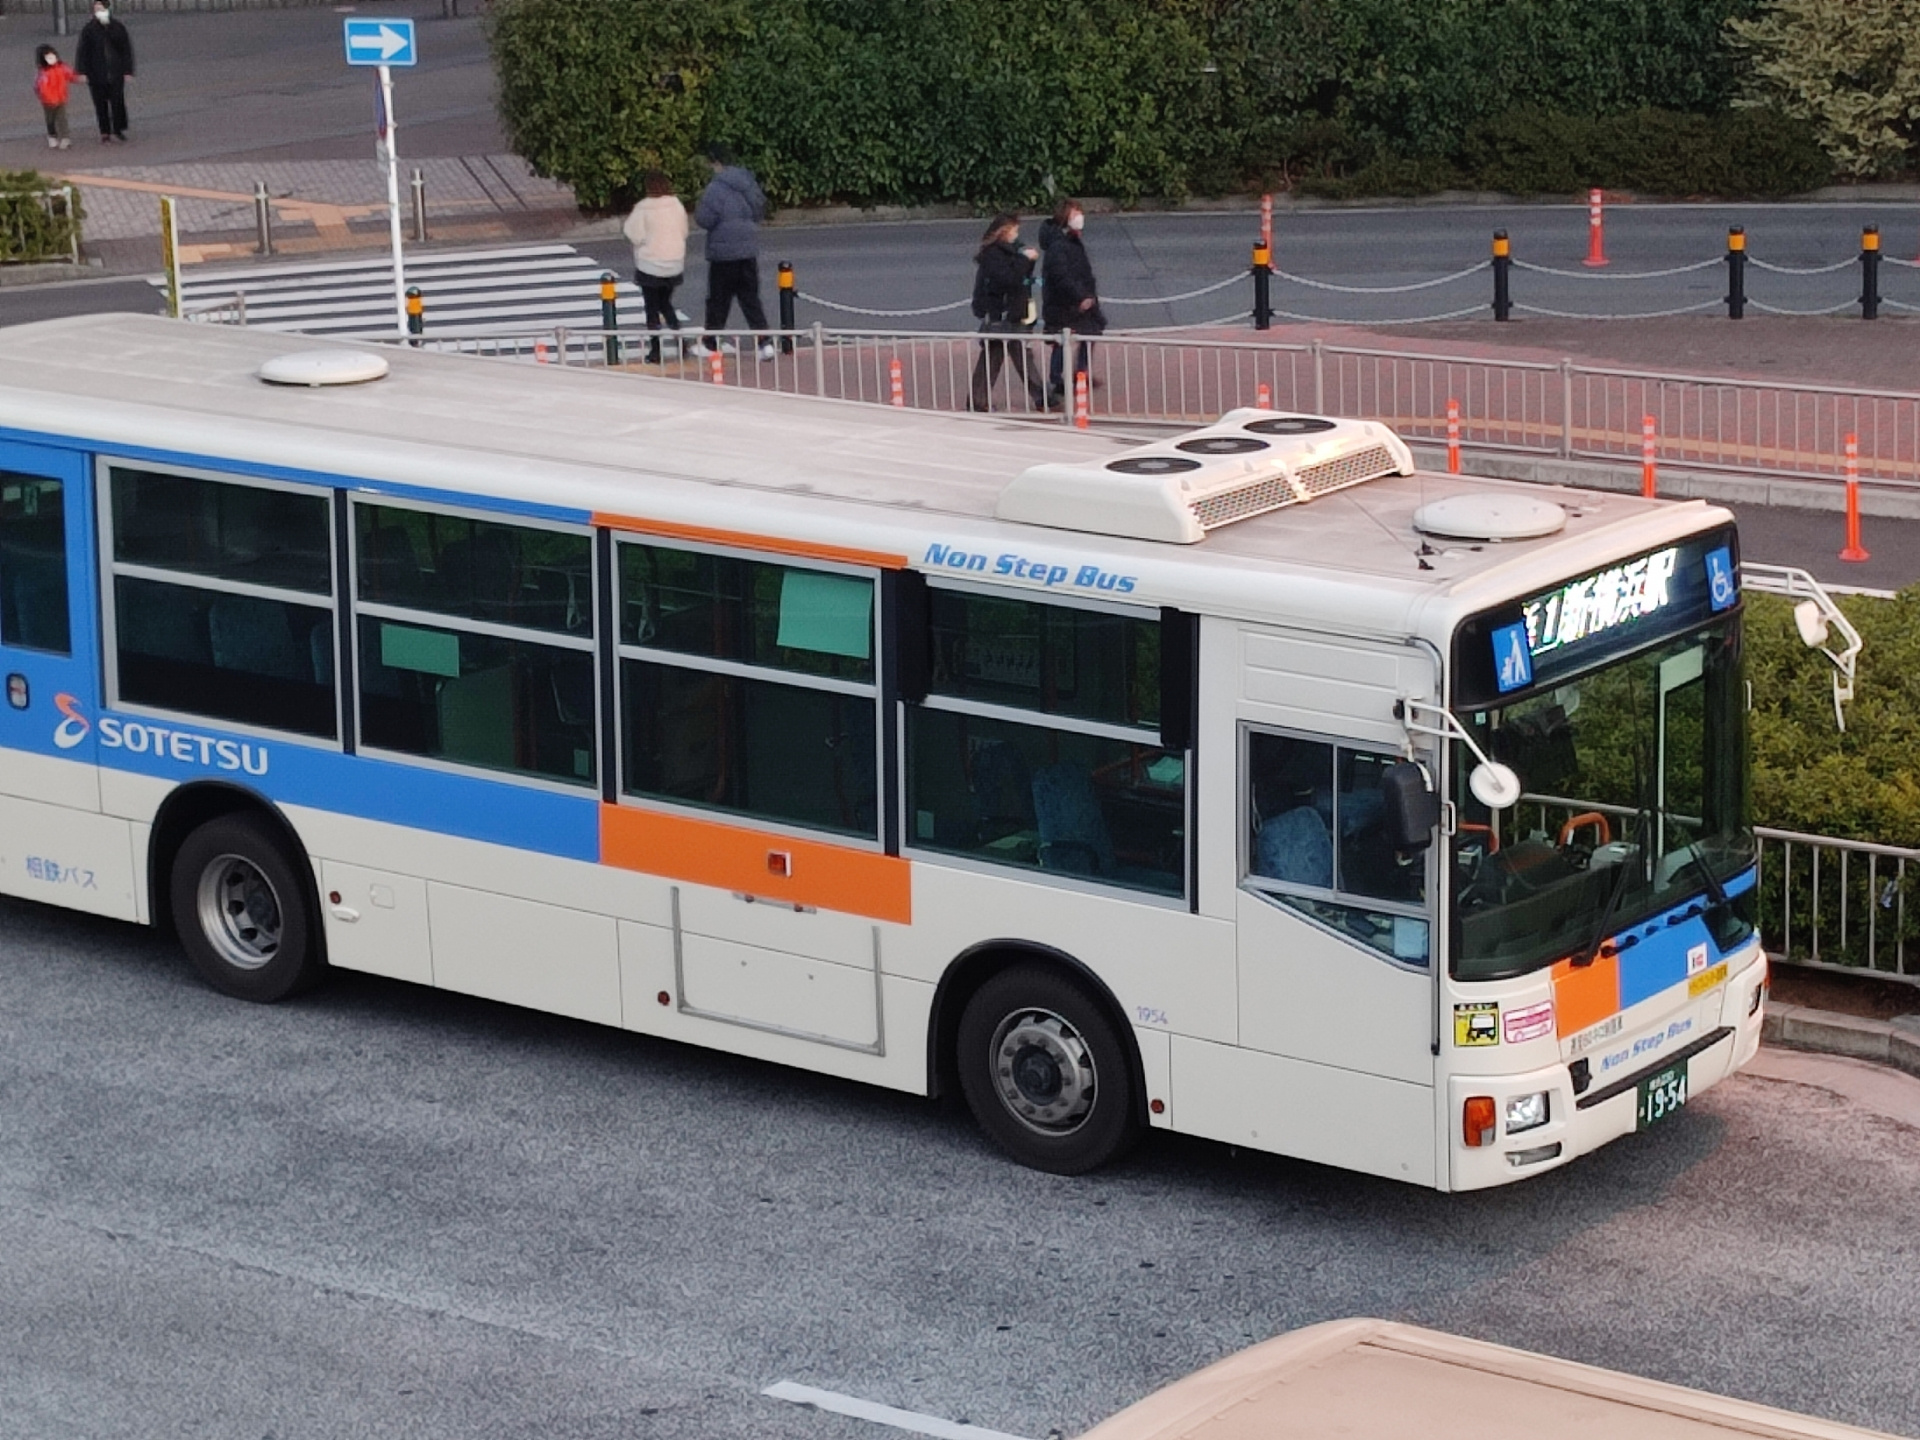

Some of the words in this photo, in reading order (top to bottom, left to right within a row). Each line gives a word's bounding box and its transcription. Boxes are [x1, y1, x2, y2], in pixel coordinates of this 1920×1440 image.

[924, 542, 988, 572] Non
[993, 553, 1069, 586] Step
[1074, 565, 1139, 594] Bus
[99, 718, 269, 776] SOTETSU
[26, 855, 98, 891] 相鉄バス
[1136, 1005, 1168, 1025] 1954
[1631, 1031, 1665, 1057] Step
